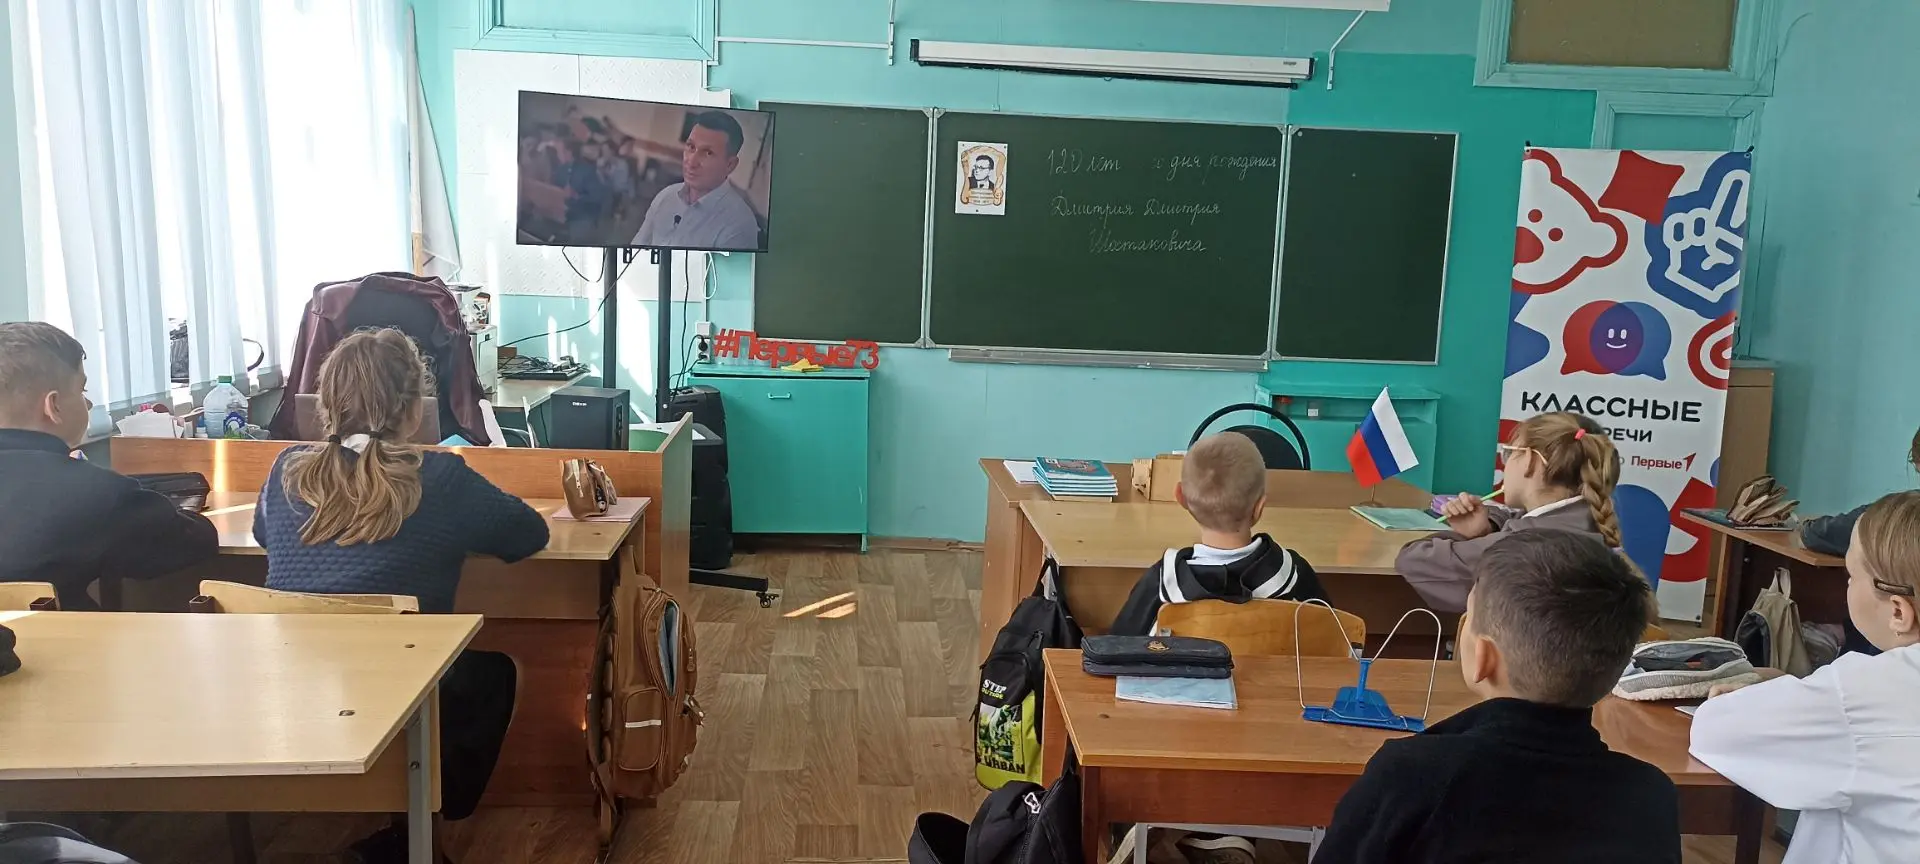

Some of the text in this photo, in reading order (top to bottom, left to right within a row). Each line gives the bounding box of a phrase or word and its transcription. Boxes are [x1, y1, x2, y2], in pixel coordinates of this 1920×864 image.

[713, 328, 880, 369] #Первые73
[1520, 390, 1703, 423] КЛАССНЫЕ
[1601, 426, 1653, 443] РЕЧИ
[1631, 455, 1683, 470] Первые
[983, 679, 1007, 693] STEP
